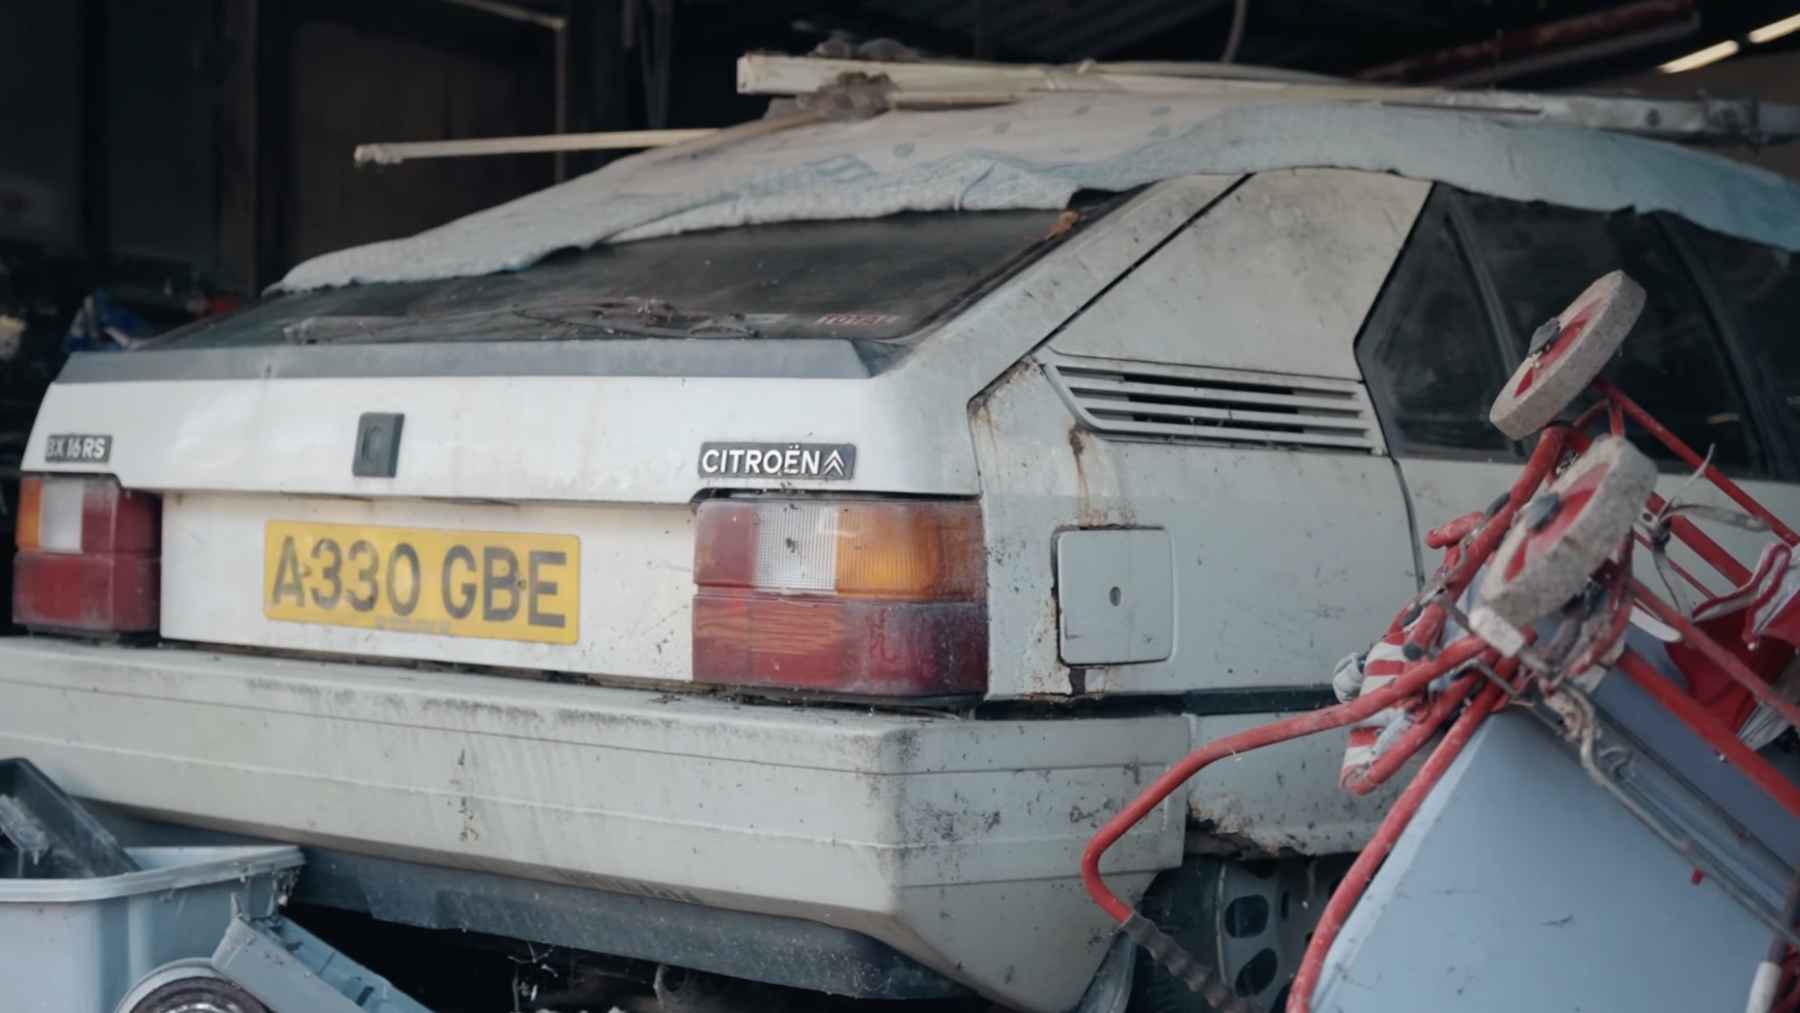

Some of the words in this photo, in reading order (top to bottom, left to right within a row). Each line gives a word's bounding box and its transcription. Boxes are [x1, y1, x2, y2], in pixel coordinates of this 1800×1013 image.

[46, 438, 64, 457] BX
[66, 437, 81, 458] 16
[82, 437, 106, 459] RS
[702, 444, 820, 475] CITROËN
[272, 535, 421, 617] A330
[441, 544, 567, 629] GBE
